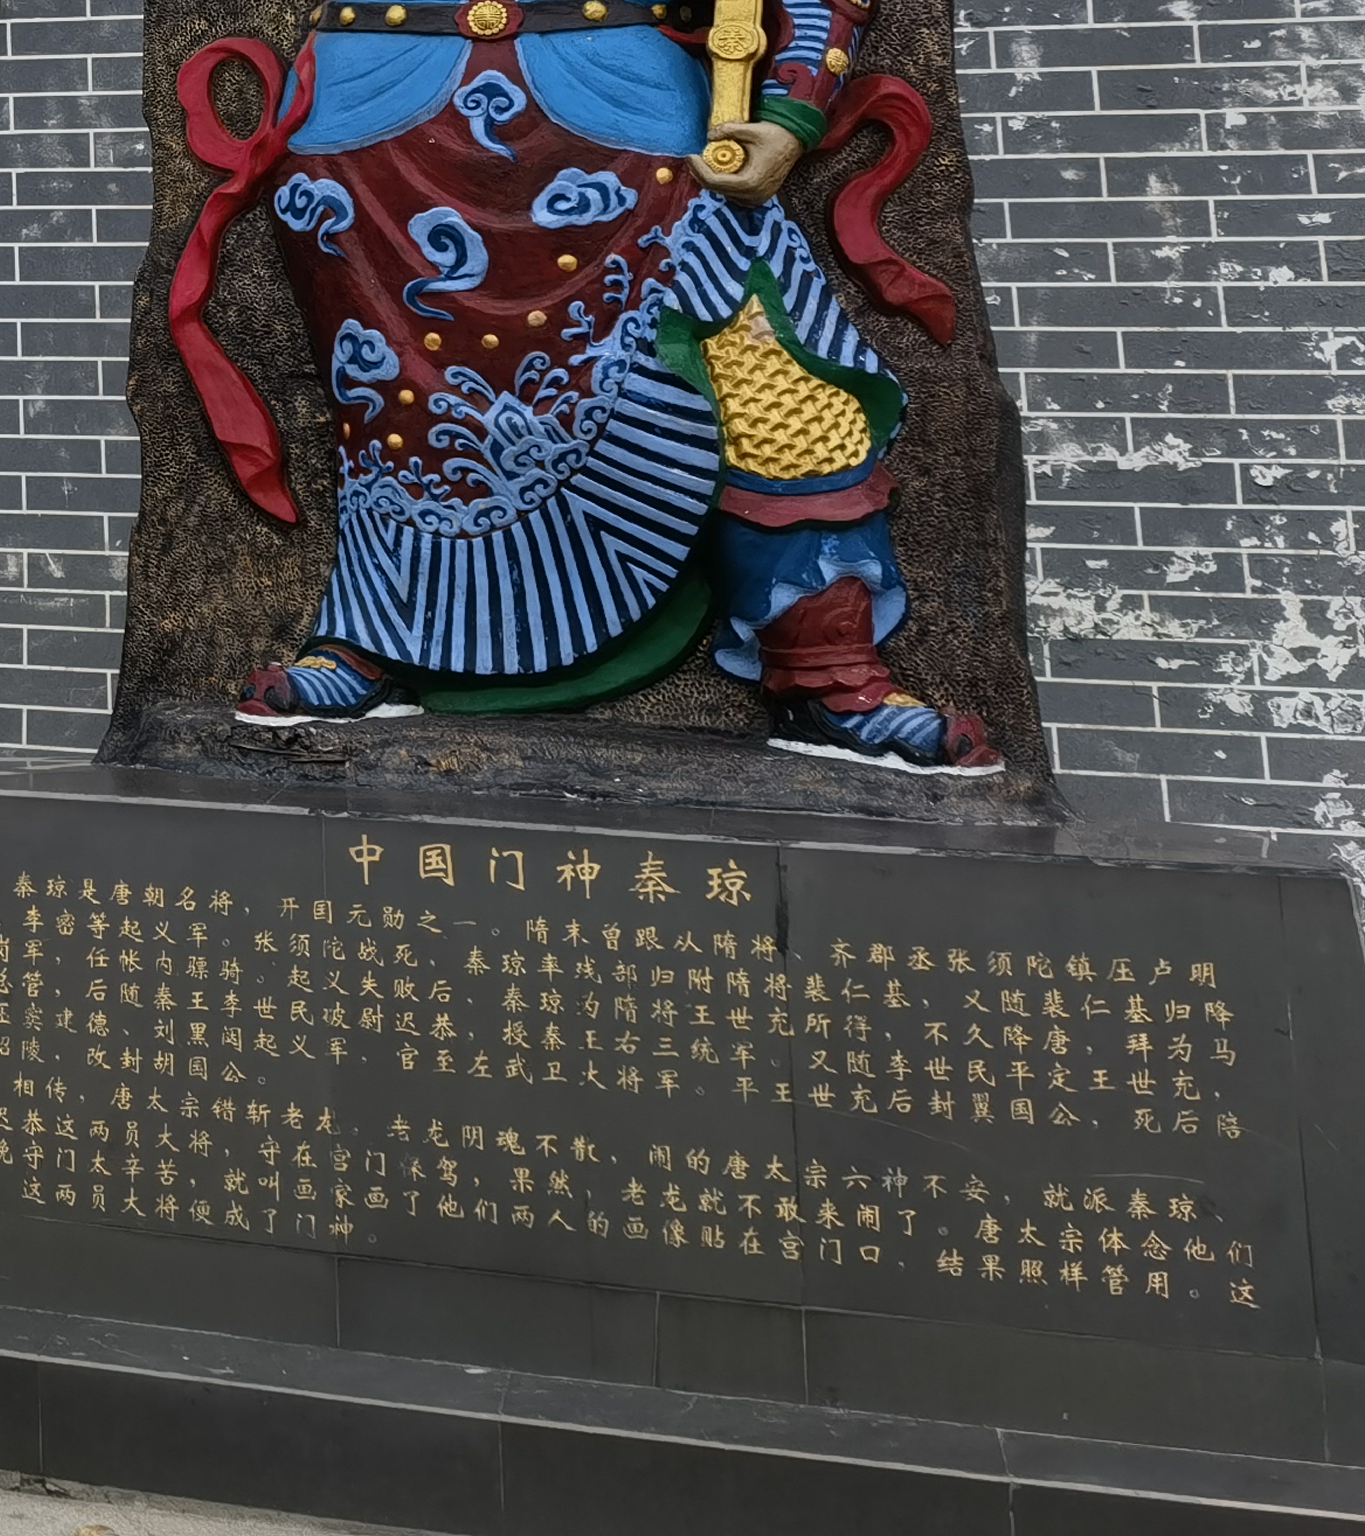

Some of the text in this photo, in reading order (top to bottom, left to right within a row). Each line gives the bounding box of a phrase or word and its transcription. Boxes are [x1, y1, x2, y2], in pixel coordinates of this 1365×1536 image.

[348, 834, 752, 906] 中国门神秦琼
